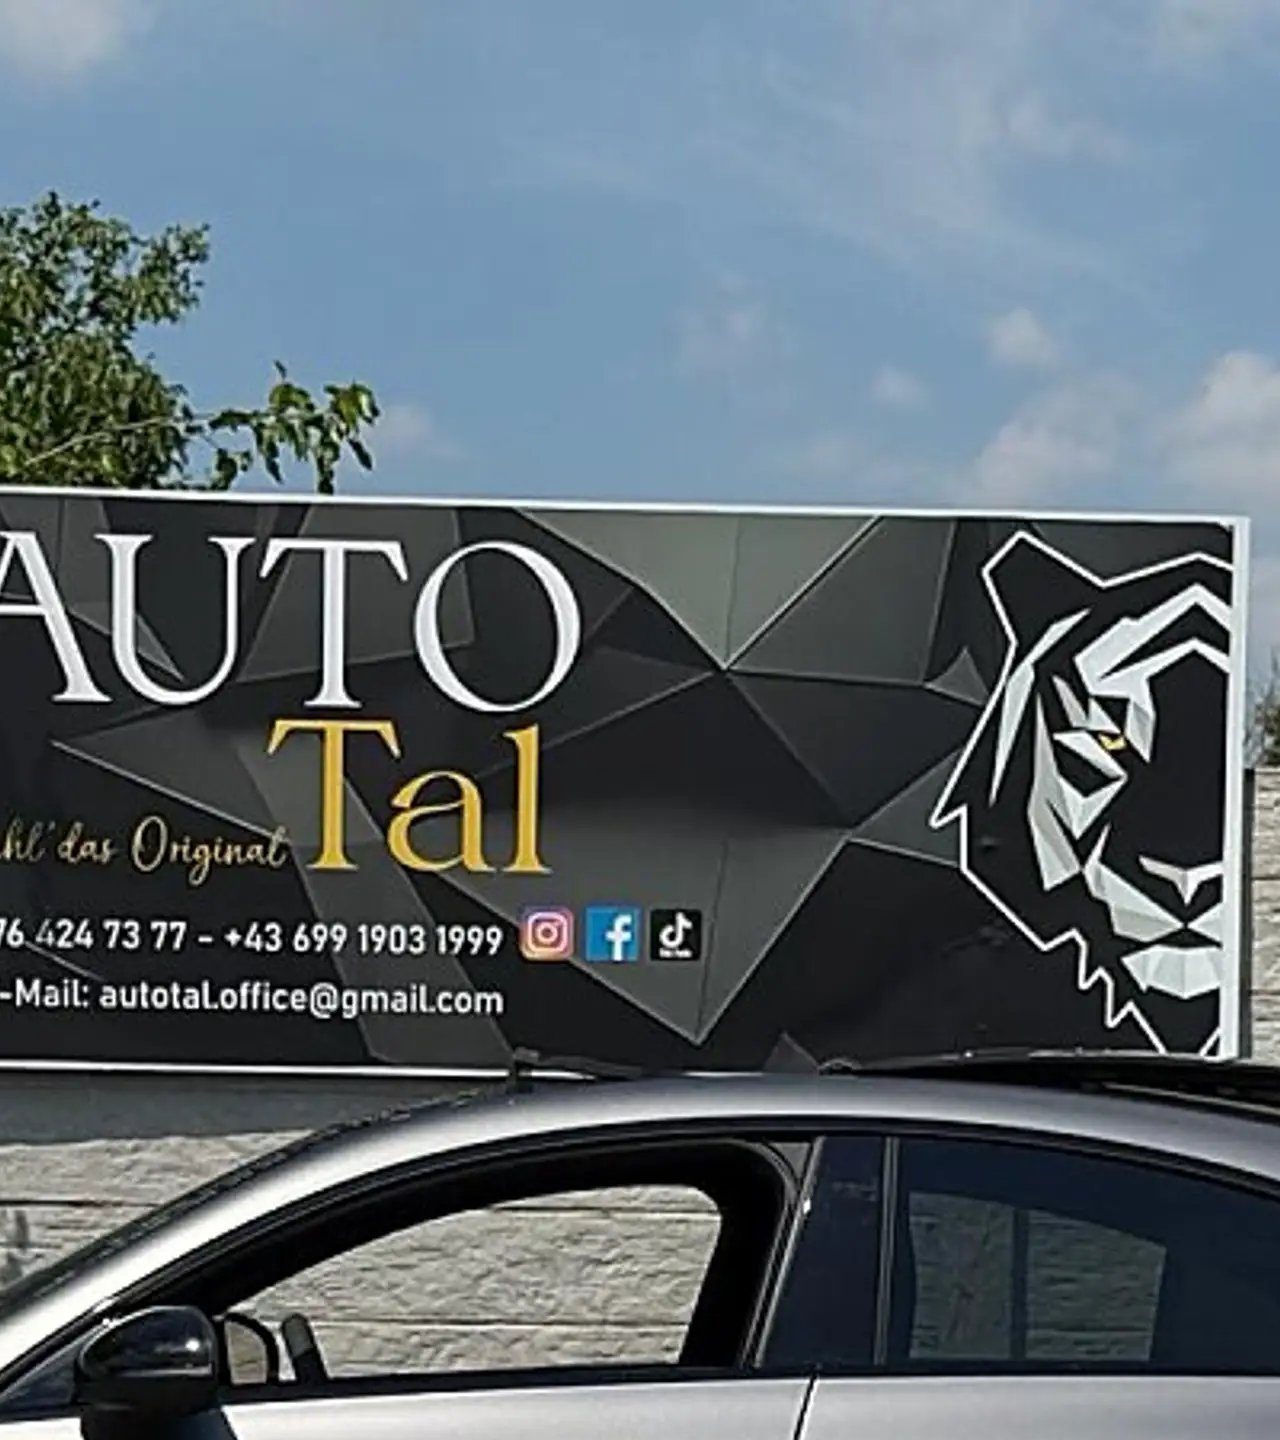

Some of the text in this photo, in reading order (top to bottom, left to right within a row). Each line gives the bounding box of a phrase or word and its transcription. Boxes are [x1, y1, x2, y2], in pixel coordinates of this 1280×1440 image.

[266, 718, 552, 875] Tal
[57, 820, 116, 864] das
[131, 814, 289, 887] Original
[34, 919, 94, 948] 424
[103, 920, 140, 949] 73
[150, 921, 187, 950] 77
[225, 922, 283, 951] +43
[293, 923, 347, 953] 699
[358, 925, 426, 954] 1903
[436, 925, 503, 955] 1999
[99, 980, 503, 1020] autotal.office@gmail.com
